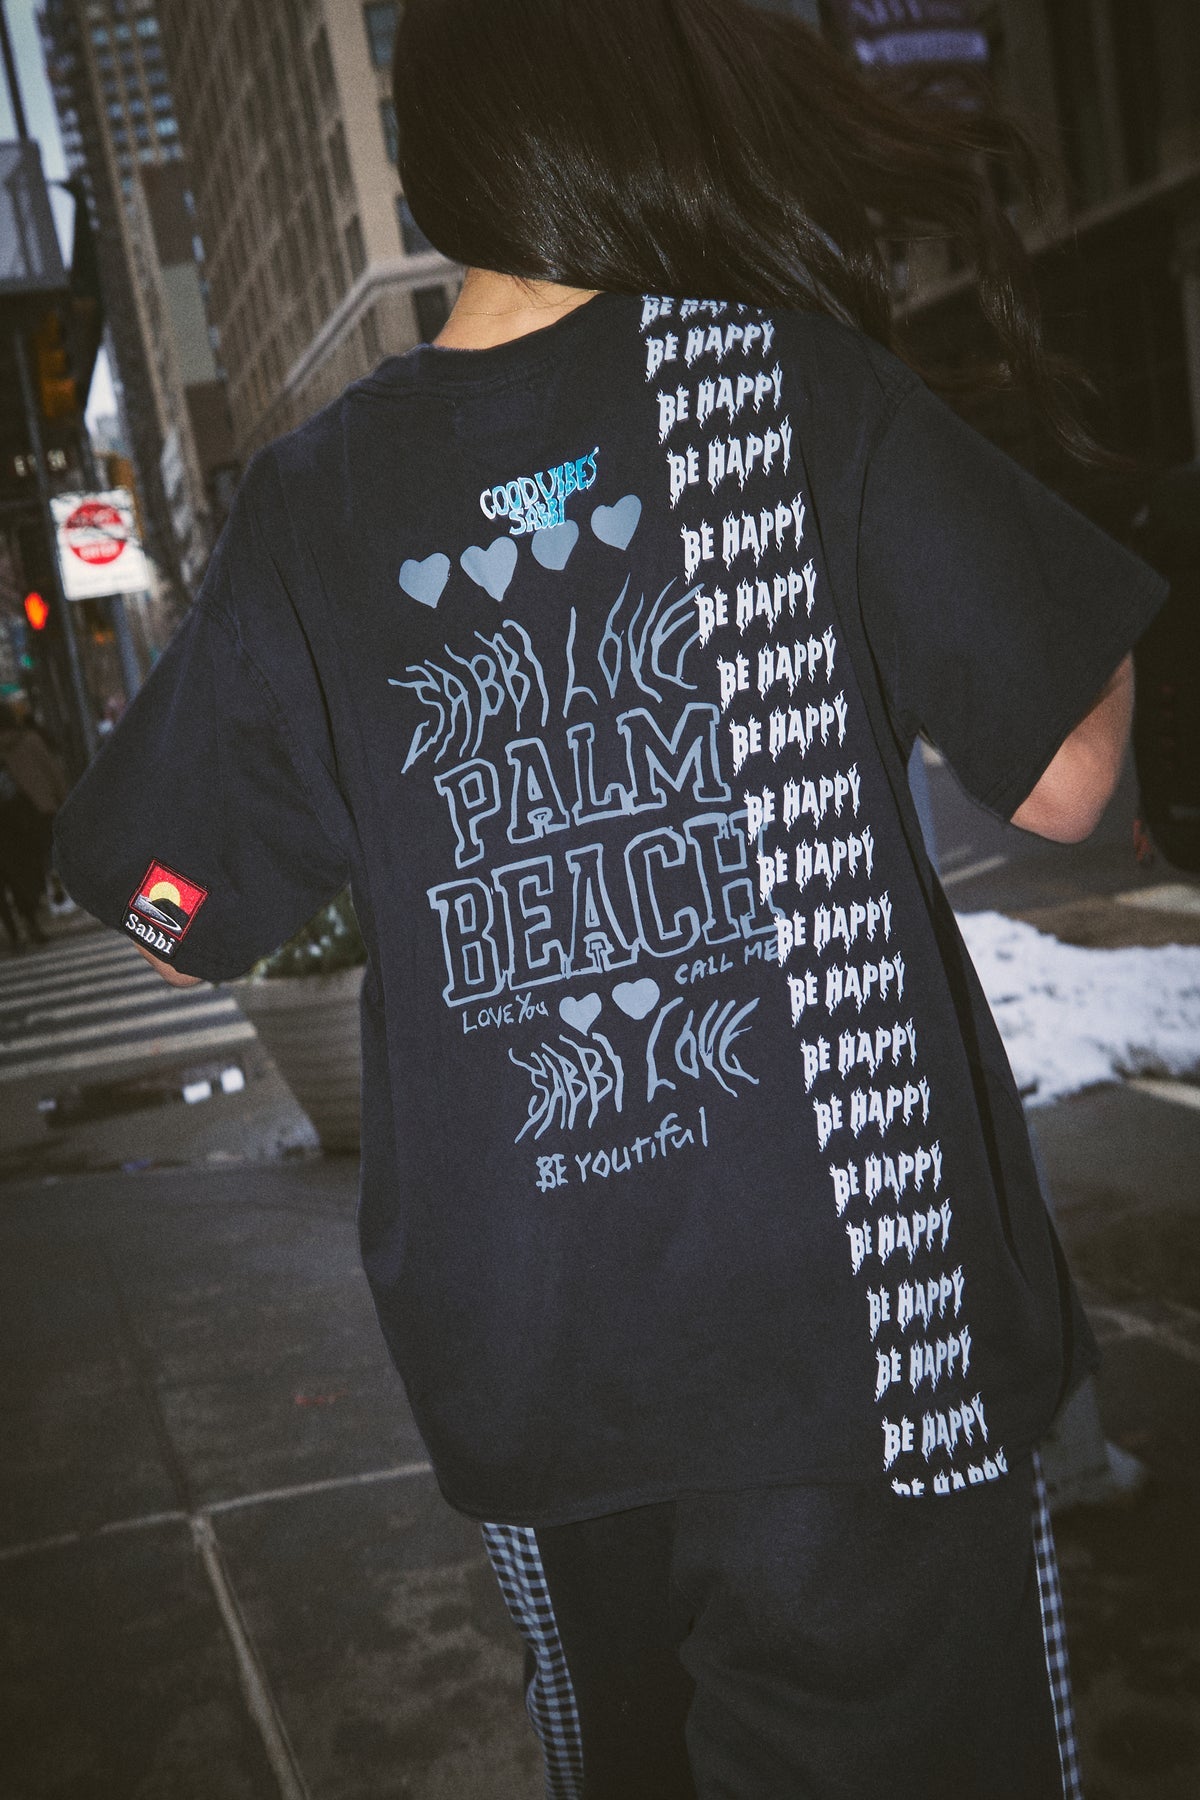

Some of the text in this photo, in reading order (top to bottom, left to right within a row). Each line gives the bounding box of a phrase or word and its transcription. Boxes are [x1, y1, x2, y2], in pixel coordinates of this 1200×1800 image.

[645, 320, 775, 383] BE HAPPY
[656, 361, 783, 445] BE HAPPY
[479, 446, 600, 520] GOOD VIBES
[666, 415, 793, 510] BE HAPPY
[679, 491, 806, 586] BE HAPPY
[694, 558, 817, 649] BE HAPPY
[562, 573, 705, 718] LOVE
[716, 624, 837, 714] BE HAPPY
[728, 689, 848, 777] BE HAPPY
[434, 702, 732, 870] PALM
[743, 762, 861, 847] BE HAPPY
[755, 824, 874, 906] BE HAPPY
[125, 913, 176, 954] Sabbi
[426, 809, 786, 1007] BEACH
[773, 890, 892, 968] BE HAPPY
[674, 934, 779, 985] CALL ME
[786, 950, 905, 1028] BE HAPPY
[462, 1003, 515, 1035] LOVE
[647, 997, 760, 1103] LOVE
[799, 1017, 917, 1094] BE HAPPY
[812, 1075, 930, 1153] BE HAPPY
[535, 1153, 569, 1193] BE
[829, 1140, 943, 1218] BE HAPPY
[845, 1197, 953, 1275] BE HAPPY
[866, 1265, 965, 1339] BE HAPPY
[874, 1324, 972, 1402] BE HAPPY
[881, 1392, 988, 1472] BE HAPPY
